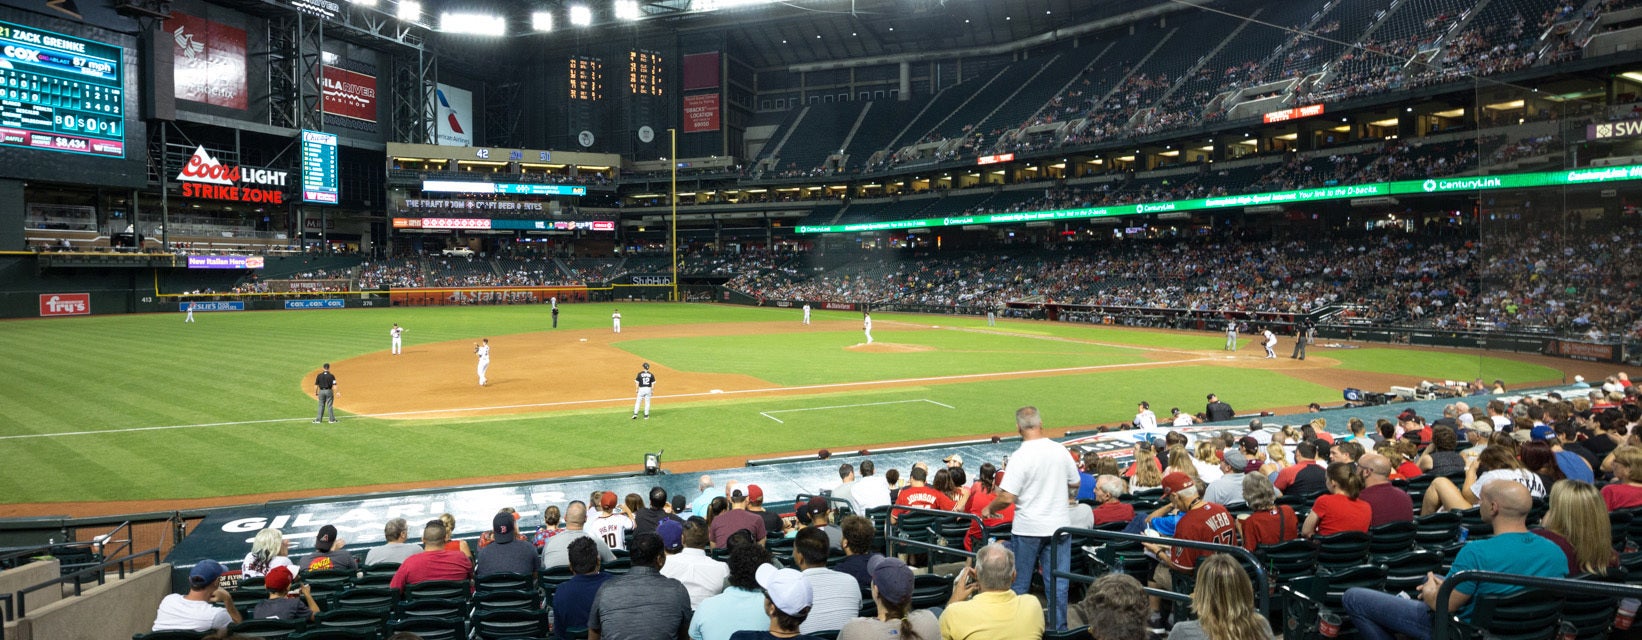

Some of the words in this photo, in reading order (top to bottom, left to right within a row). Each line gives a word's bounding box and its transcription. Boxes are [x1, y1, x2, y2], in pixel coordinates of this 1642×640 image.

[12, 30, 41, 44] ZACK
[43, 36, 85, 53] GREINKE
[73, 56, 86, 67] 87
[88, 60, 112, 73] mph
[343, 82, 375, 98] RIVER
[325, 96, 365, 108] CASINOS
[56, 116, 62, 124] B
[64, 115, 75, 127] 0
[78, 119, 84, 127] S
[86, 118, 96, 130] 0
[110, 122, 116, 133] 1
[56, 137, 86, 149] $8,434
[477, 149, 488, 158] 42
[183, 154, 241, 181] Coors
[242, 167, 287, 186] LIGHT
[1440, 178, 1501, 190] CenturyLink
[182, 182, 239, 201] STRIKE
[242, 188, 282, 204] ZONE
[1300, 191, 1313, 199] Your
[1144, 204, 1174, 212] CenturyLink
[632, 276, 670, 285] StubHub
[46, 296, 86, 313] fry's
[907, 493, 936, 504] JOHNSON
[1205, 512, 1230, 532] WEBB
[602, 533, 616, 548] 10
